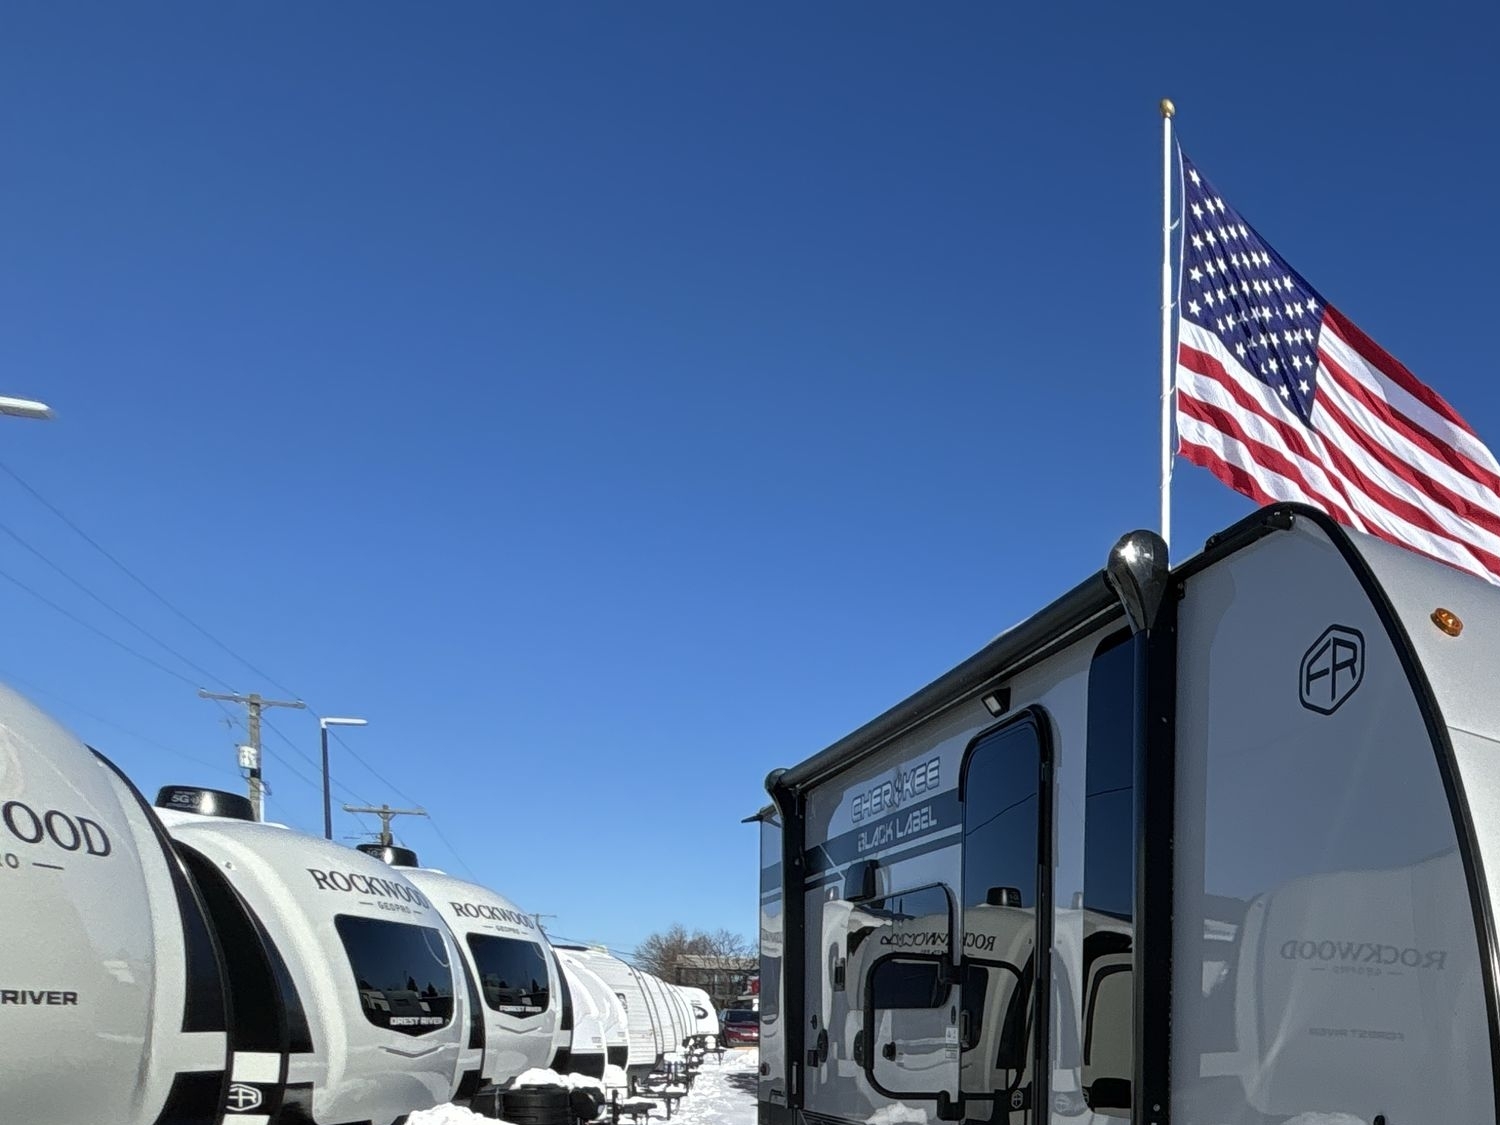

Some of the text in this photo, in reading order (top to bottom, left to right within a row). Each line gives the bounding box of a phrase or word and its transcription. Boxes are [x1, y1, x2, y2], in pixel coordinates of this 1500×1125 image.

[858, 805, 938, 853] BLACK LABEL
[306, 868, 430, 910] ROCKWOOD
[449, 901, 535, 930] ROCKWOOD
[0, 989, 79, 1006] RIVER
